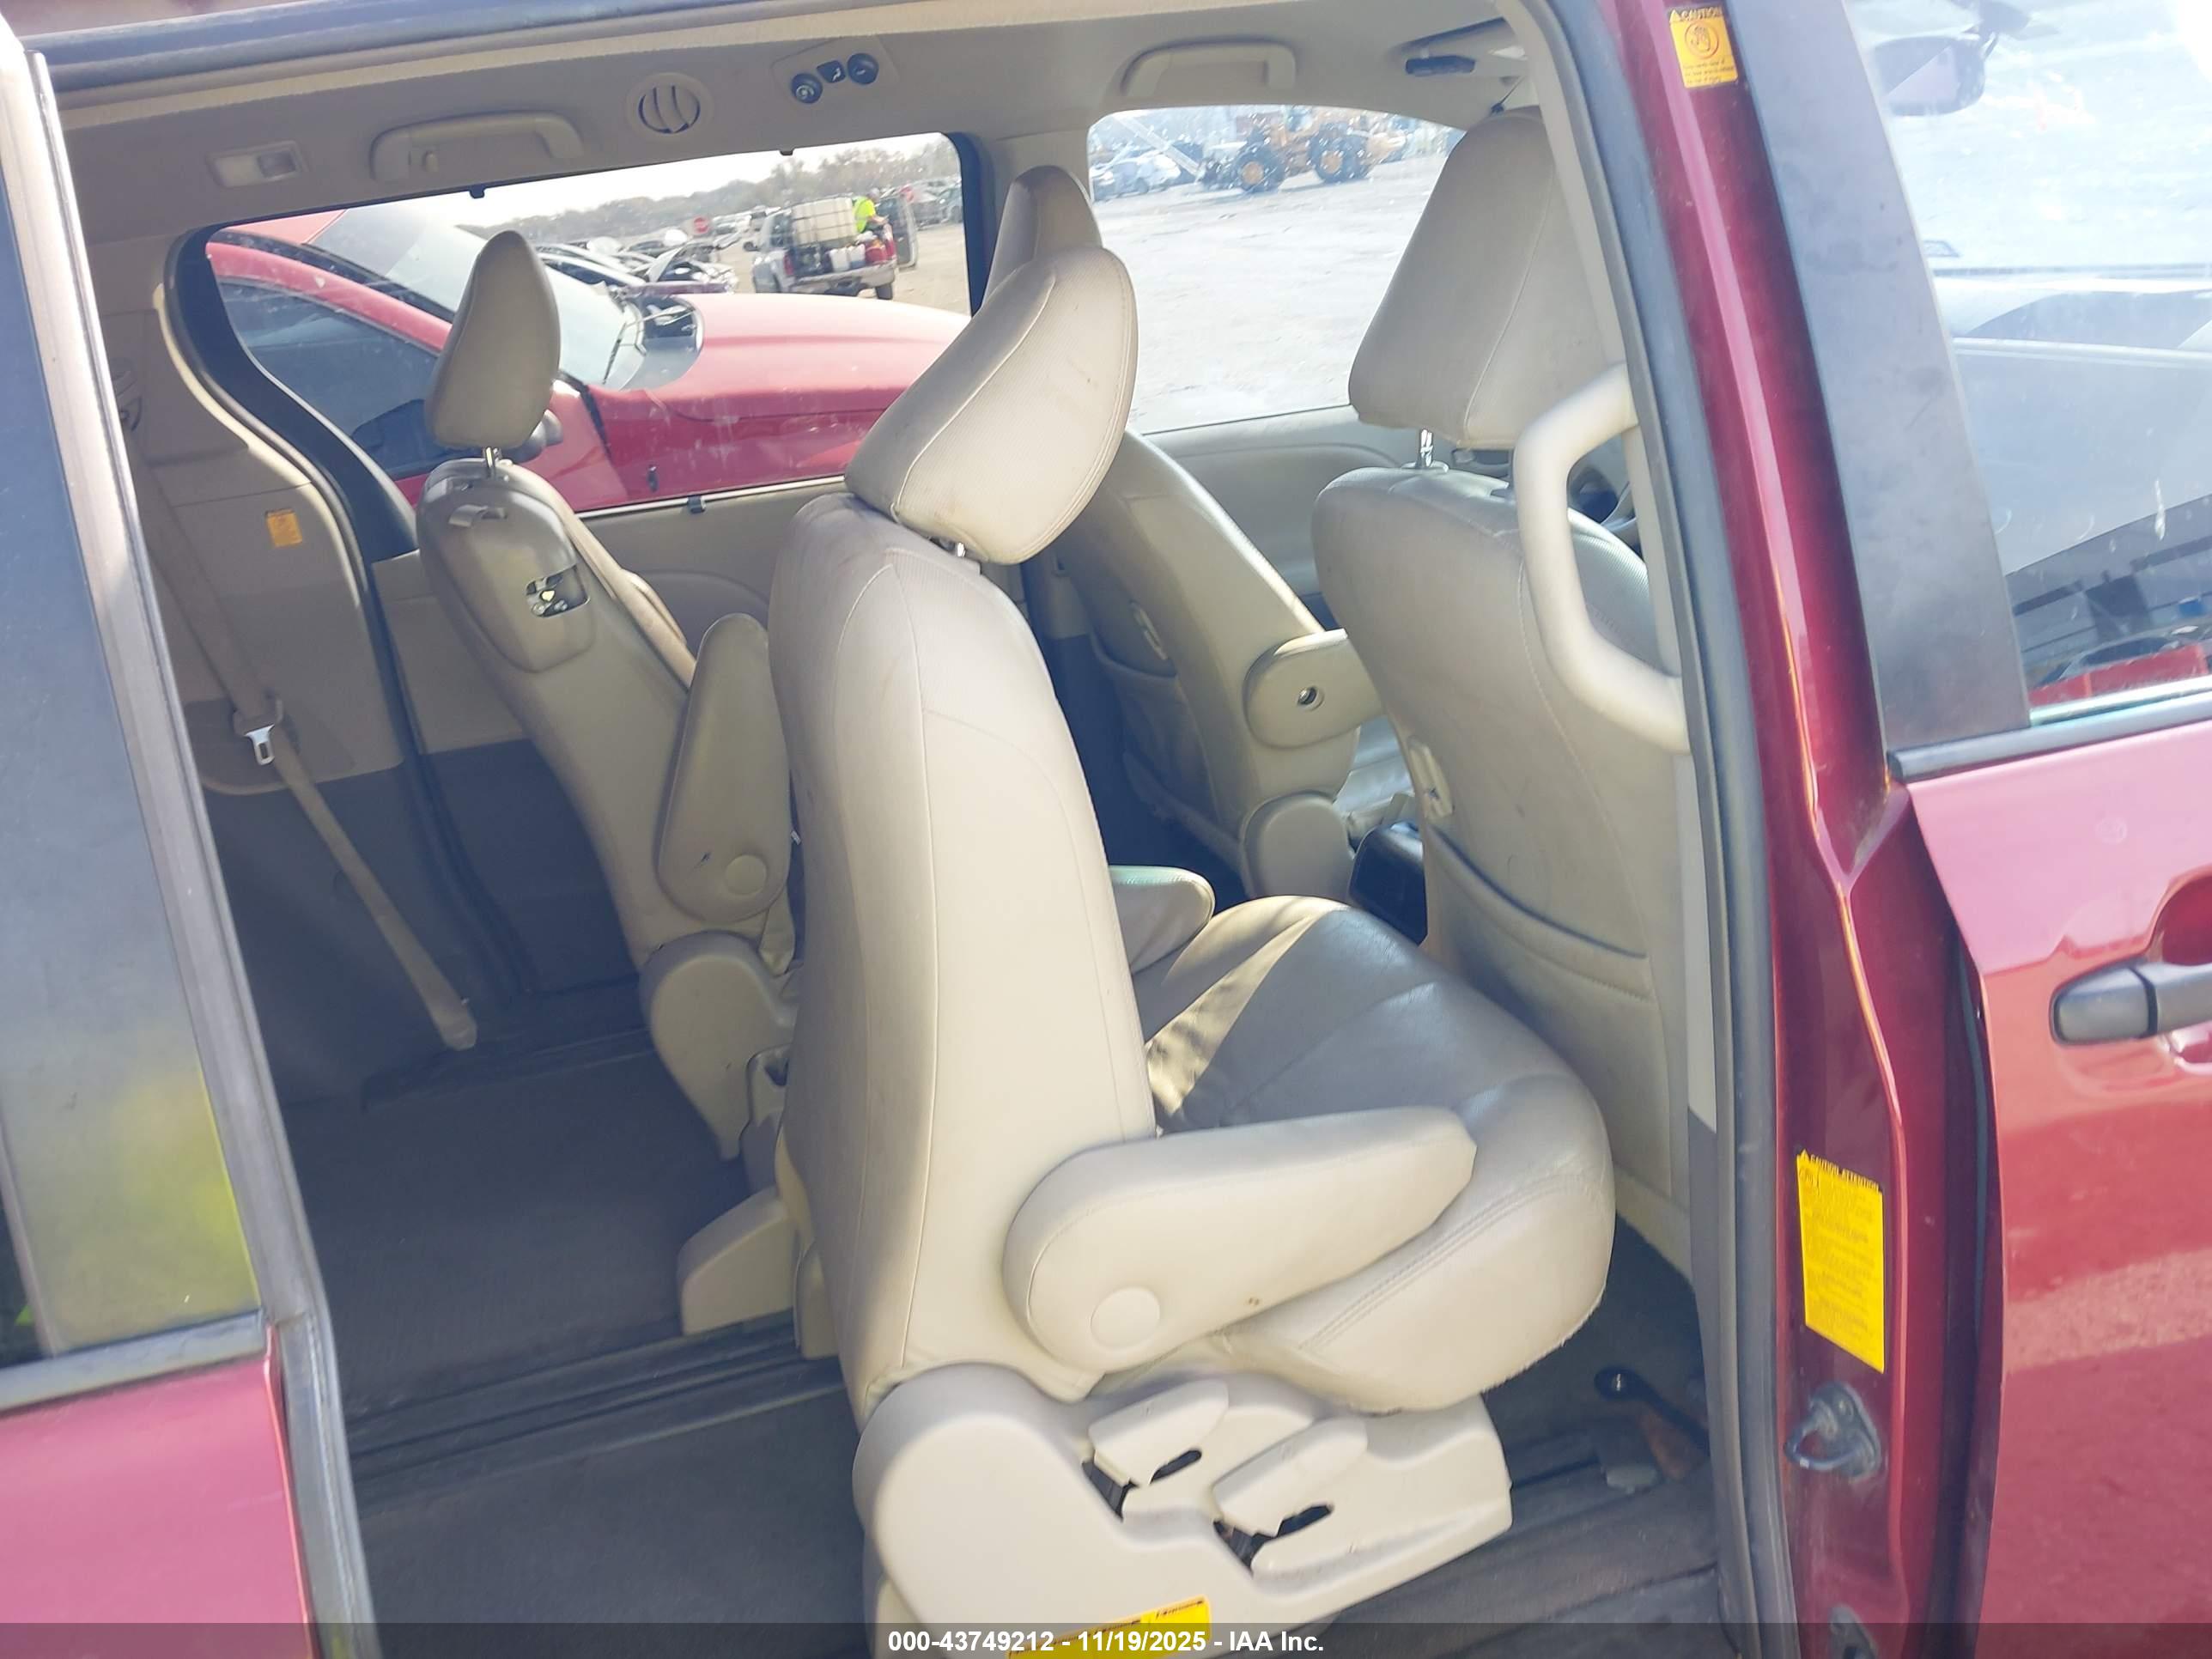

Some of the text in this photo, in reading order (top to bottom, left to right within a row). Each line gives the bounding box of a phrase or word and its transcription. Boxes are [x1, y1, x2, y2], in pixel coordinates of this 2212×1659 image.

[1680, 7, 1723, 21] CAUTION
[1810, 1153, 1879, 1193] CAUTION ATTENTION
